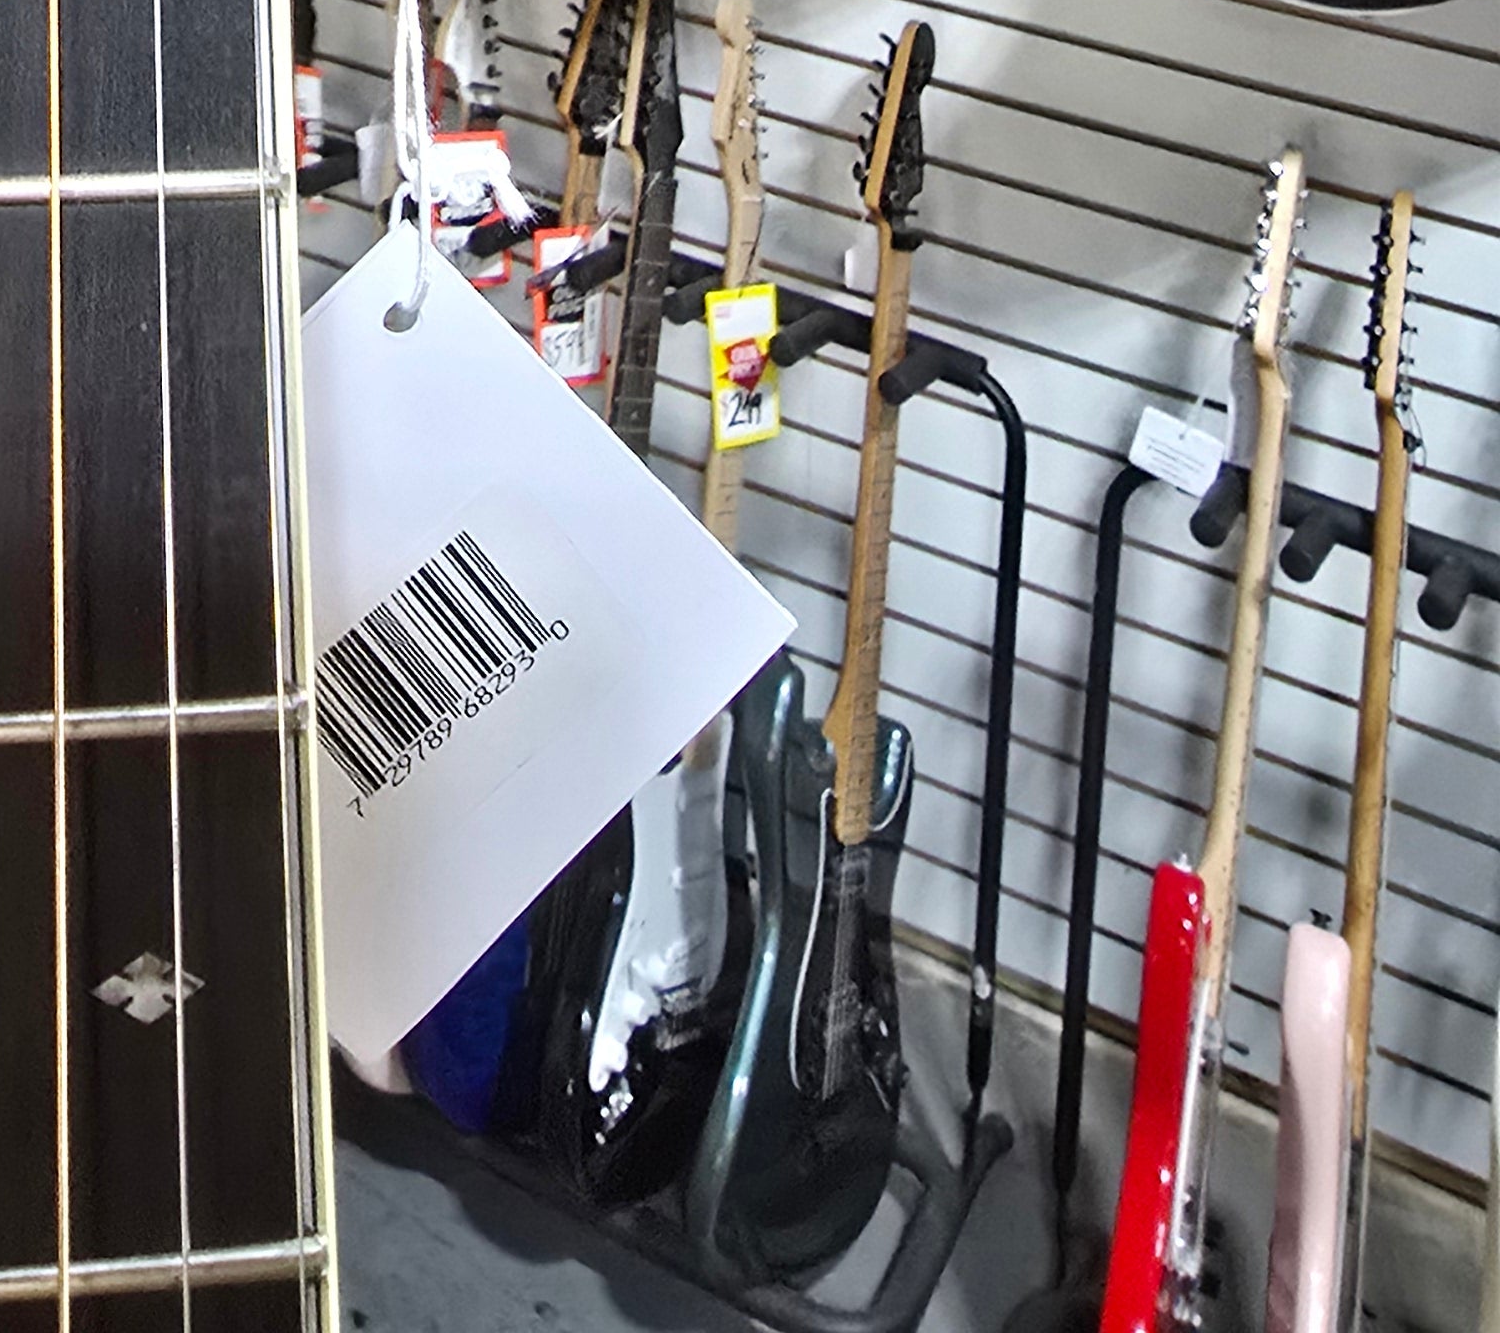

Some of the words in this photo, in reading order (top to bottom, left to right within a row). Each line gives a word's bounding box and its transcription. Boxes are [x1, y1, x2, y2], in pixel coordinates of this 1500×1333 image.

[347, 796, 364, 817] 7
[384, 718, 452, 787] 29789
[463, 648, 536, 718] 68293
[550, 619, 570, 641] 0
